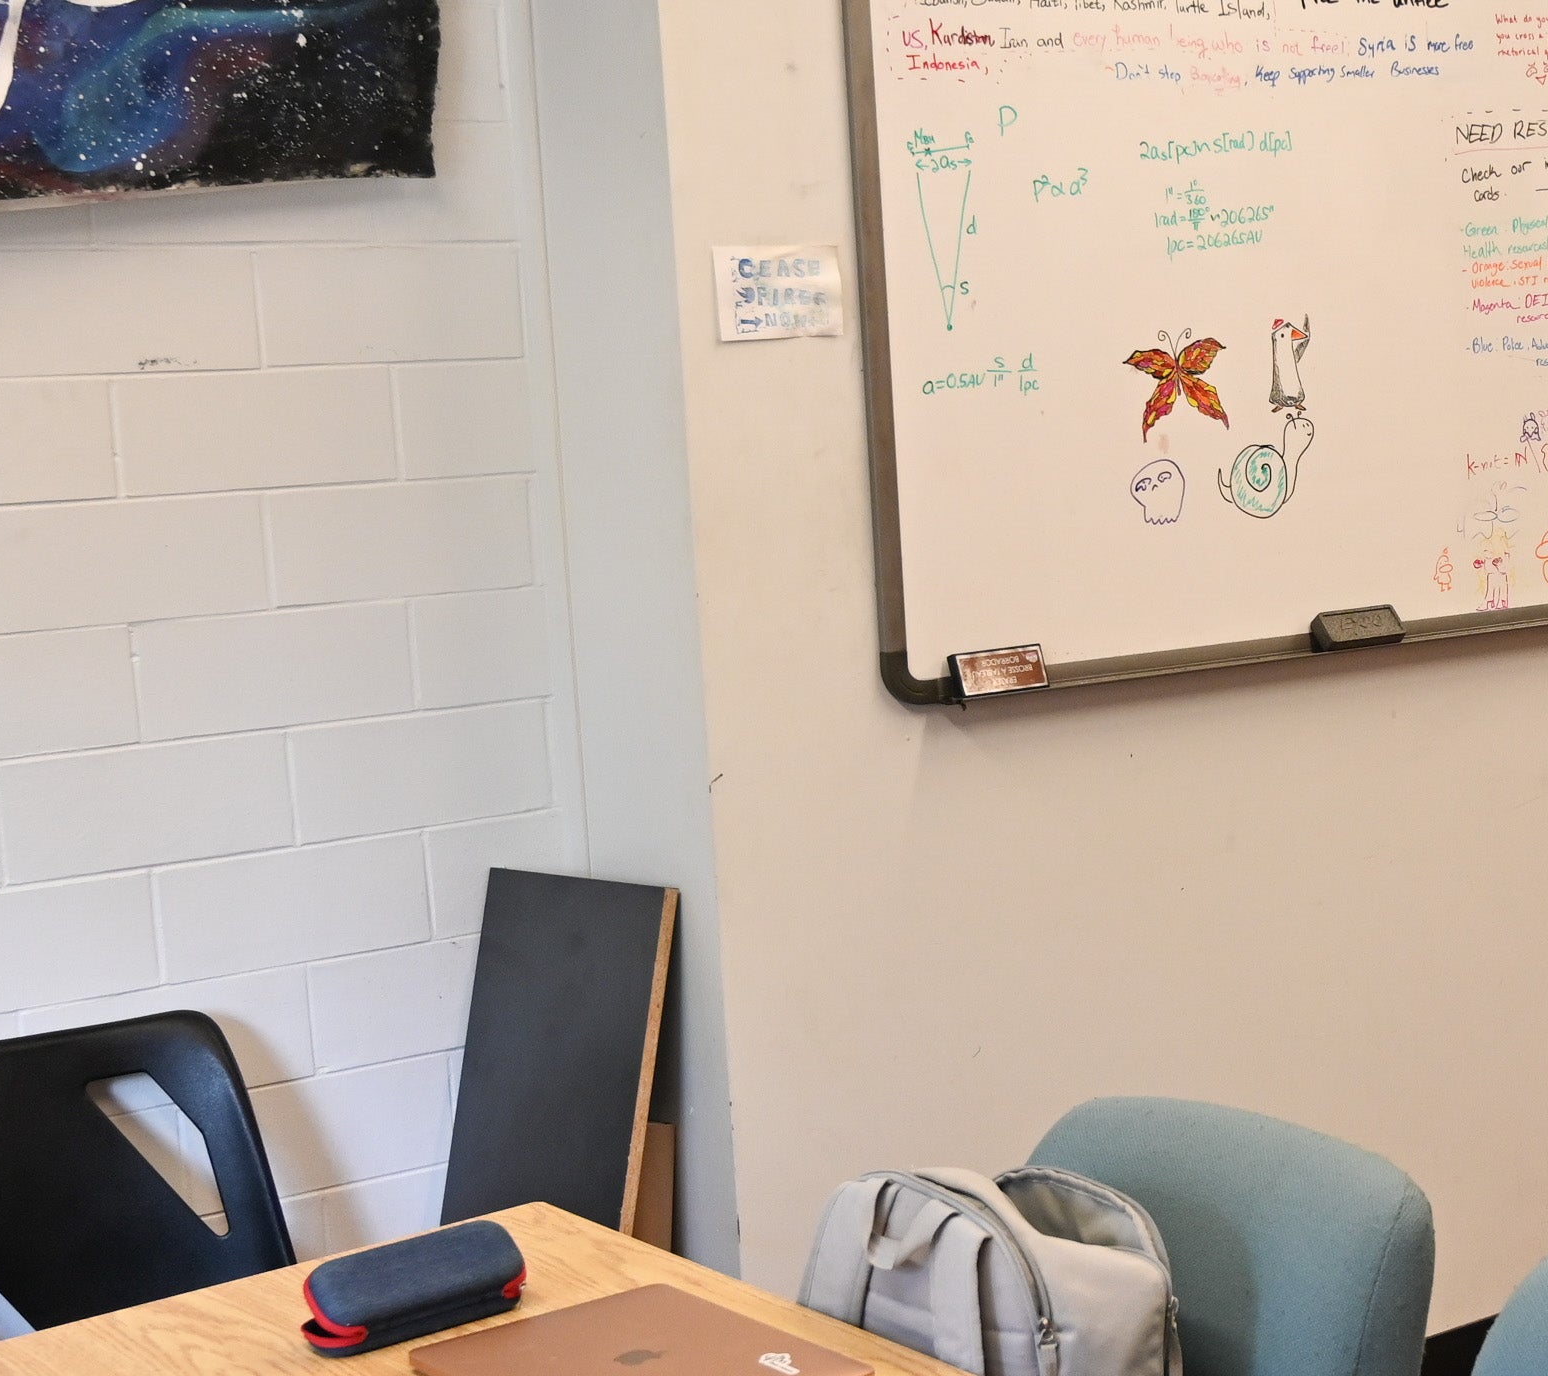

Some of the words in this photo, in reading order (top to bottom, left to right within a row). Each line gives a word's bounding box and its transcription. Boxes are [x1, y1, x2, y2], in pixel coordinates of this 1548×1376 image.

[1495, 14, 1518, 25] What
[1523, 14, 1532, 24] do
[1036, 33, 1064, 49] and
[1212, 31, 1243, 53] who
[1496, 33, 1511, 44] you
[1456, 123, 1502, 145] NEED
[1461, 164, 1502, 183] Check
[1510, 161, 1532, 175] our
